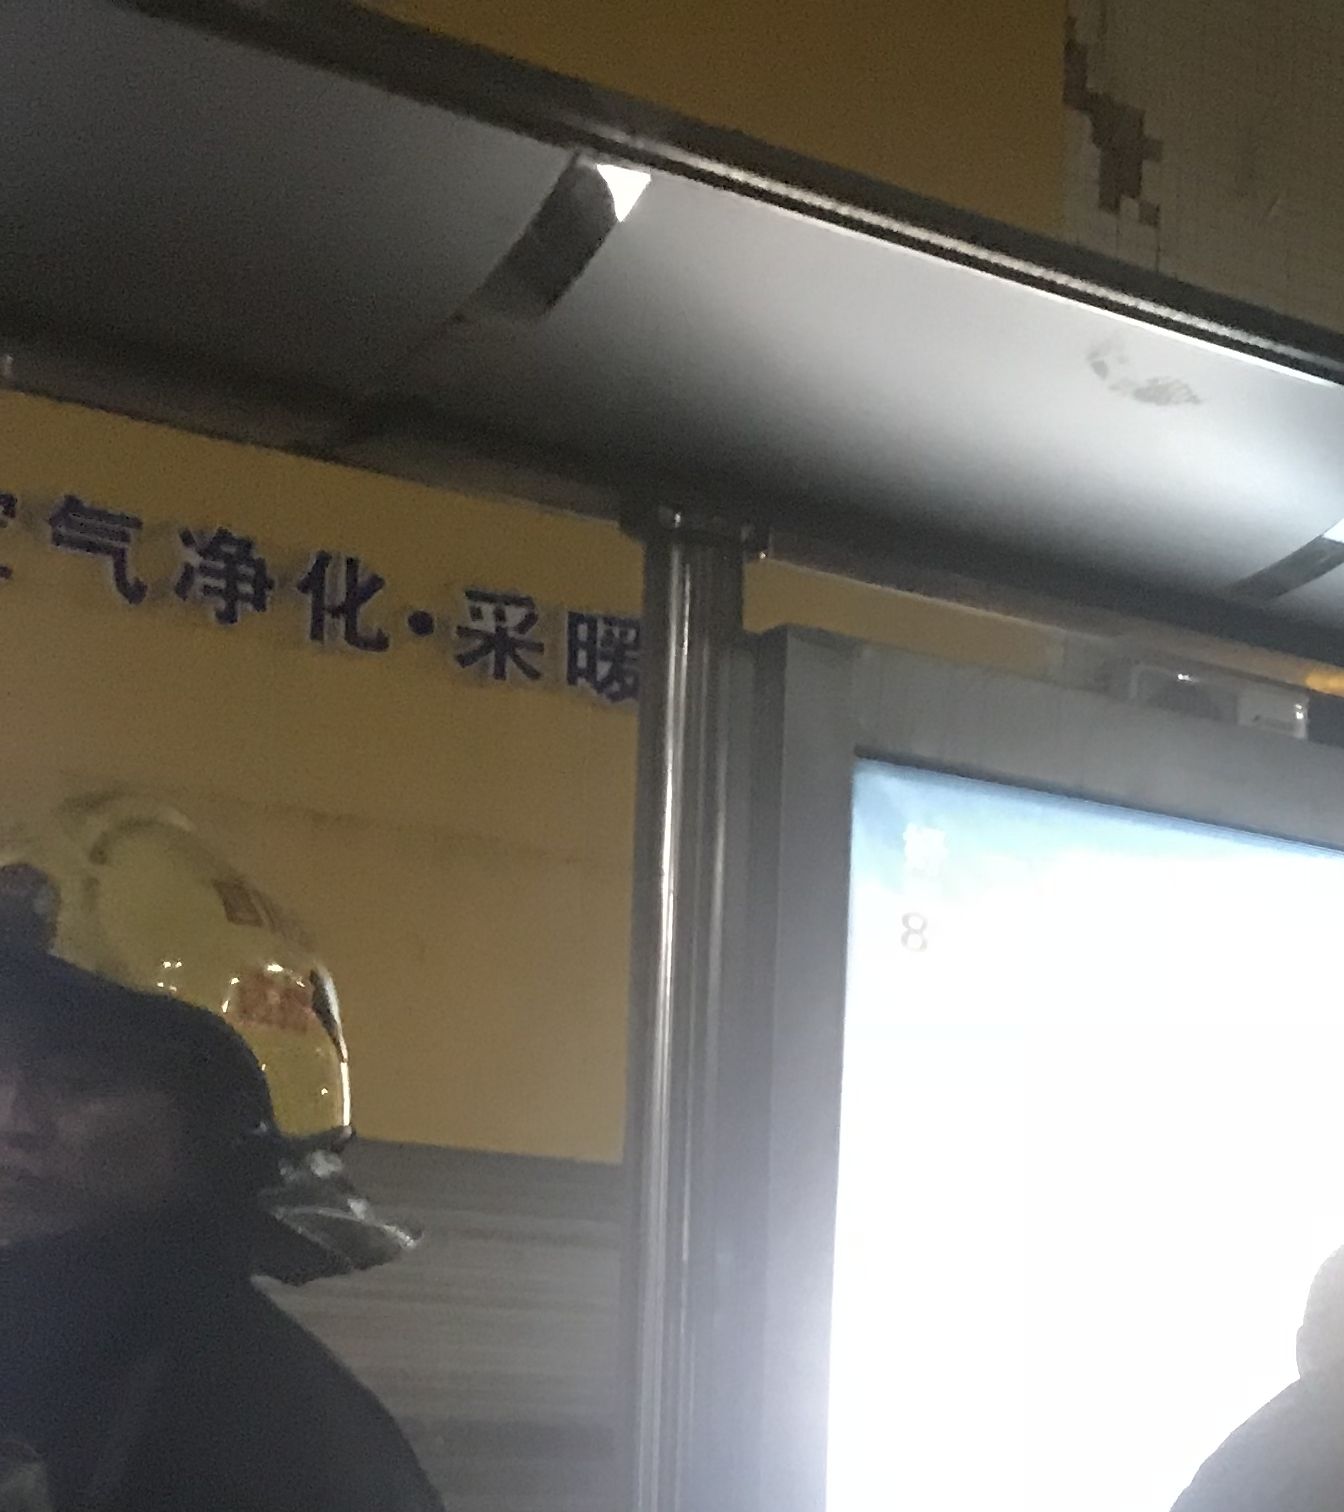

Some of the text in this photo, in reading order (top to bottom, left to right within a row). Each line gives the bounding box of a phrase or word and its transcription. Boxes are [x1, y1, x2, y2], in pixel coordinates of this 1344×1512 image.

[0, 492, 644, 702] 气净化·采暖
